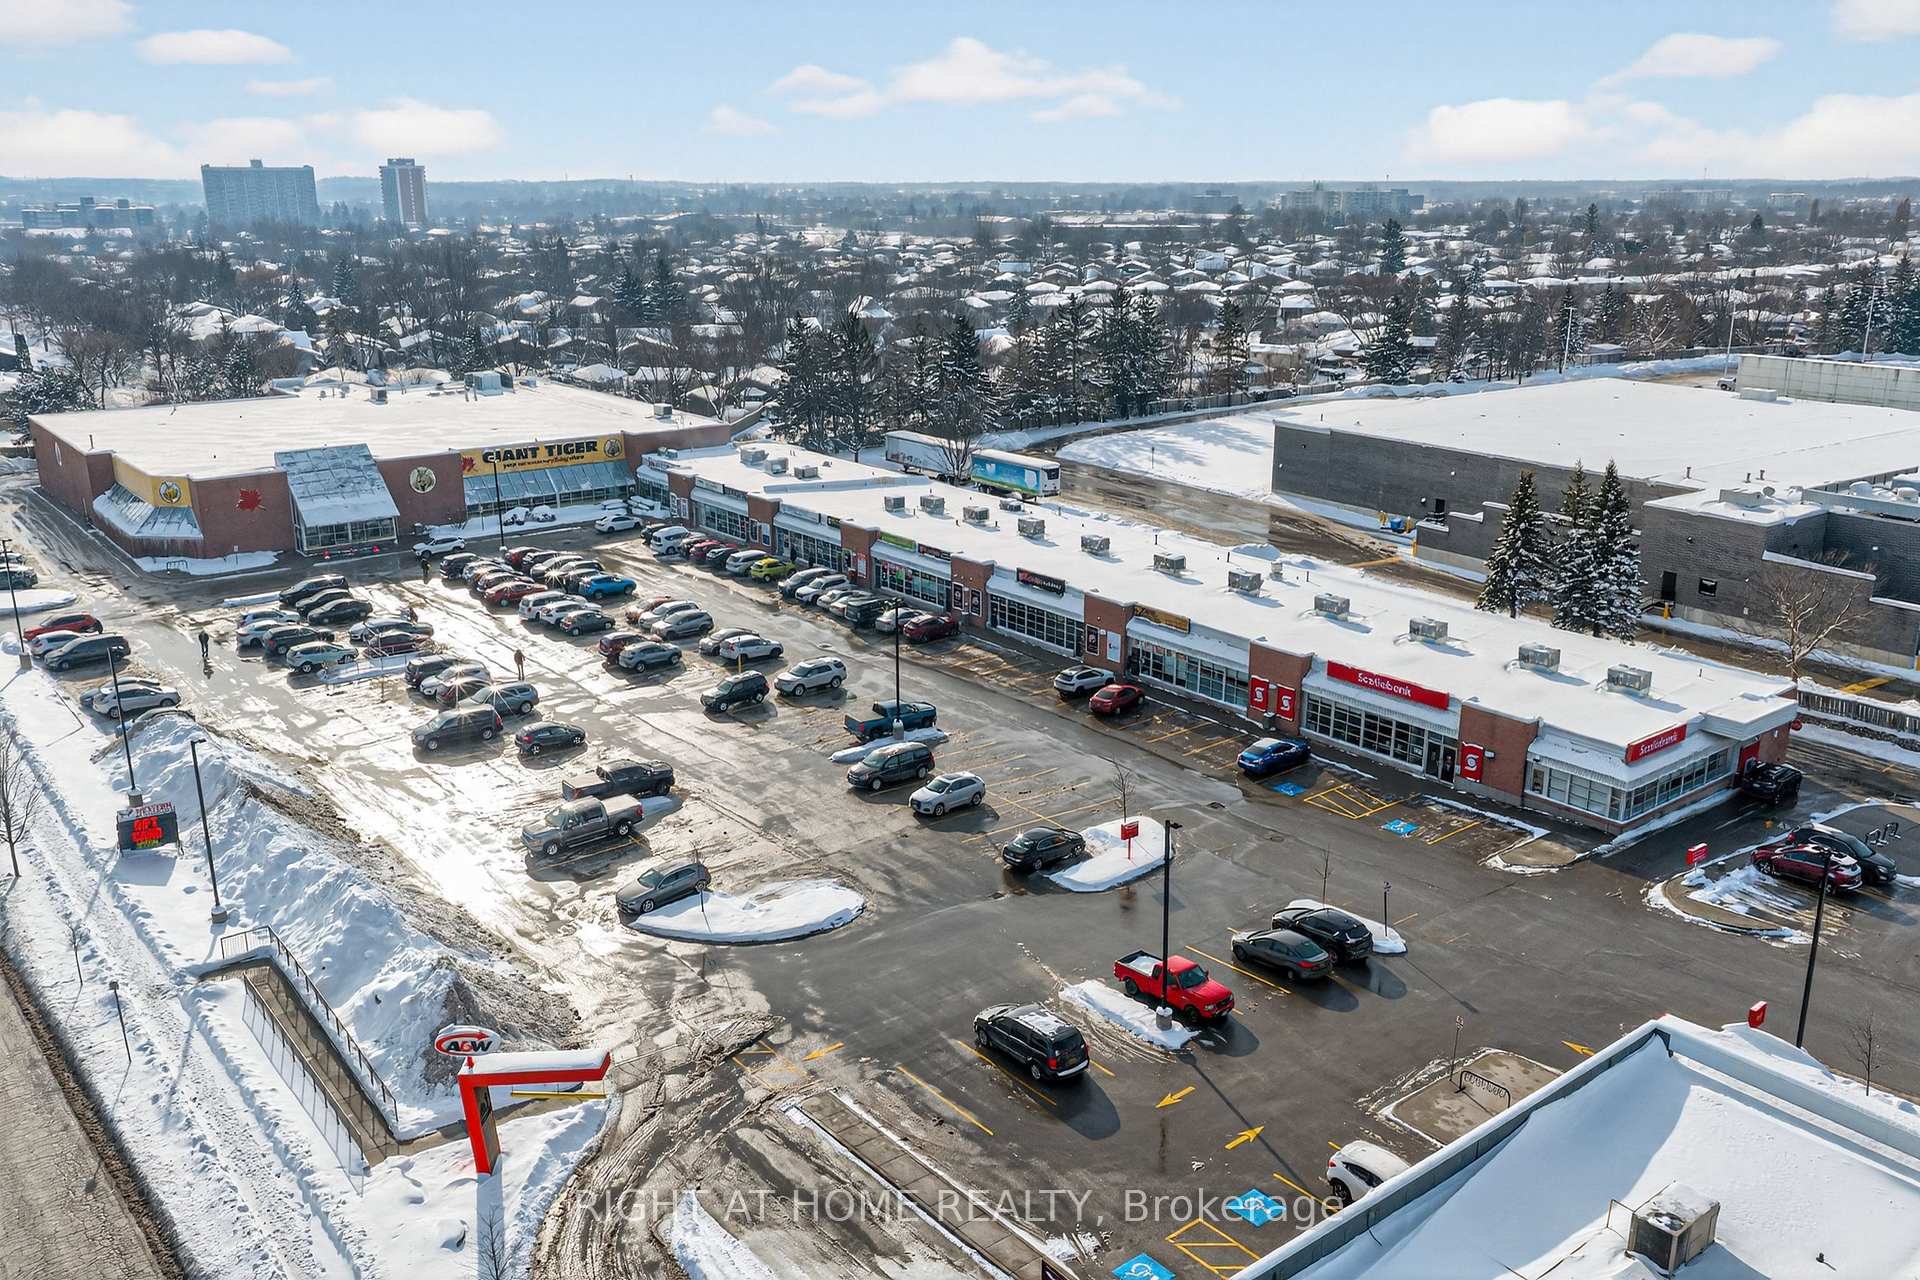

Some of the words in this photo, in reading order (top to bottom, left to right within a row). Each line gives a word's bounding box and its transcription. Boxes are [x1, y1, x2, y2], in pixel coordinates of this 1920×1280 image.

[482, 446, 539, 464] GIANT
[544, 440, 598, 457] TIGER
[447, 1040, 493, 1052] A&W
